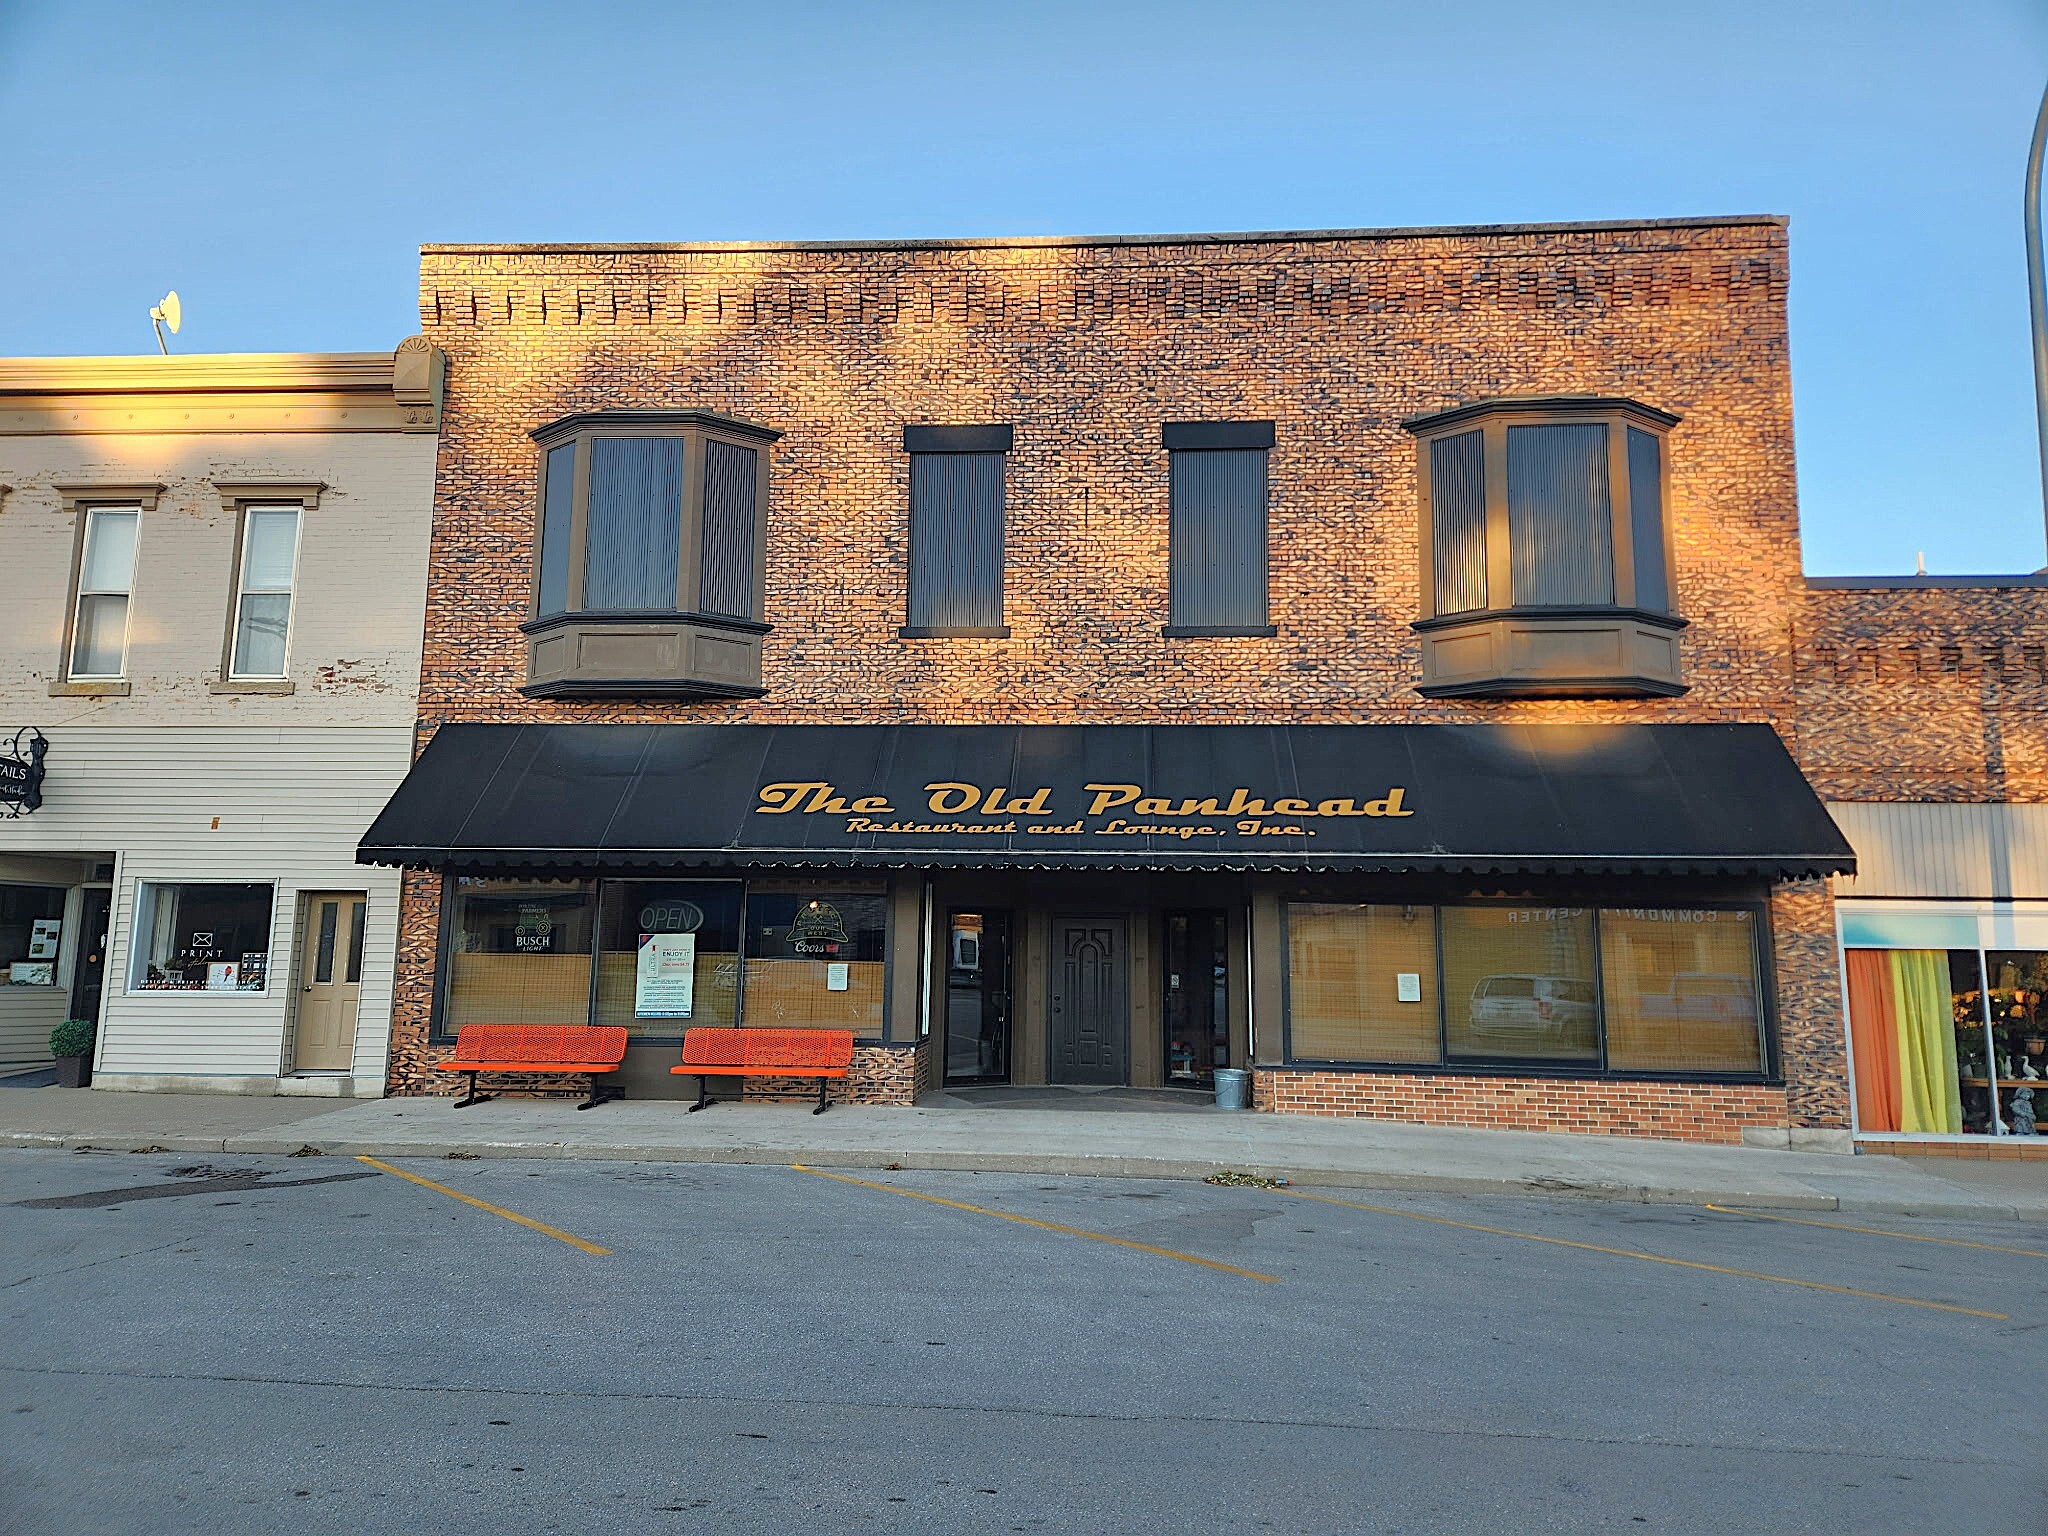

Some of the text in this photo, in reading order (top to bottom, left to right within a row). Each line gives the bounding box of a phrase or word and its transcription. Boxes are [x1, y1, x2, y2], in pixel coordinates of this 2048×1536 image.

[755, 782, 1415, 817] The Old Panhead
[846, 818, 1316, 839] Restaurant and Lounge, Inc.
[640, 907, 692, 929] OPEN
[516, 936, 551, 947] BUSCH
[795, 940, 825, 953] Coors
[180, 949, 223, 958] PRINT
